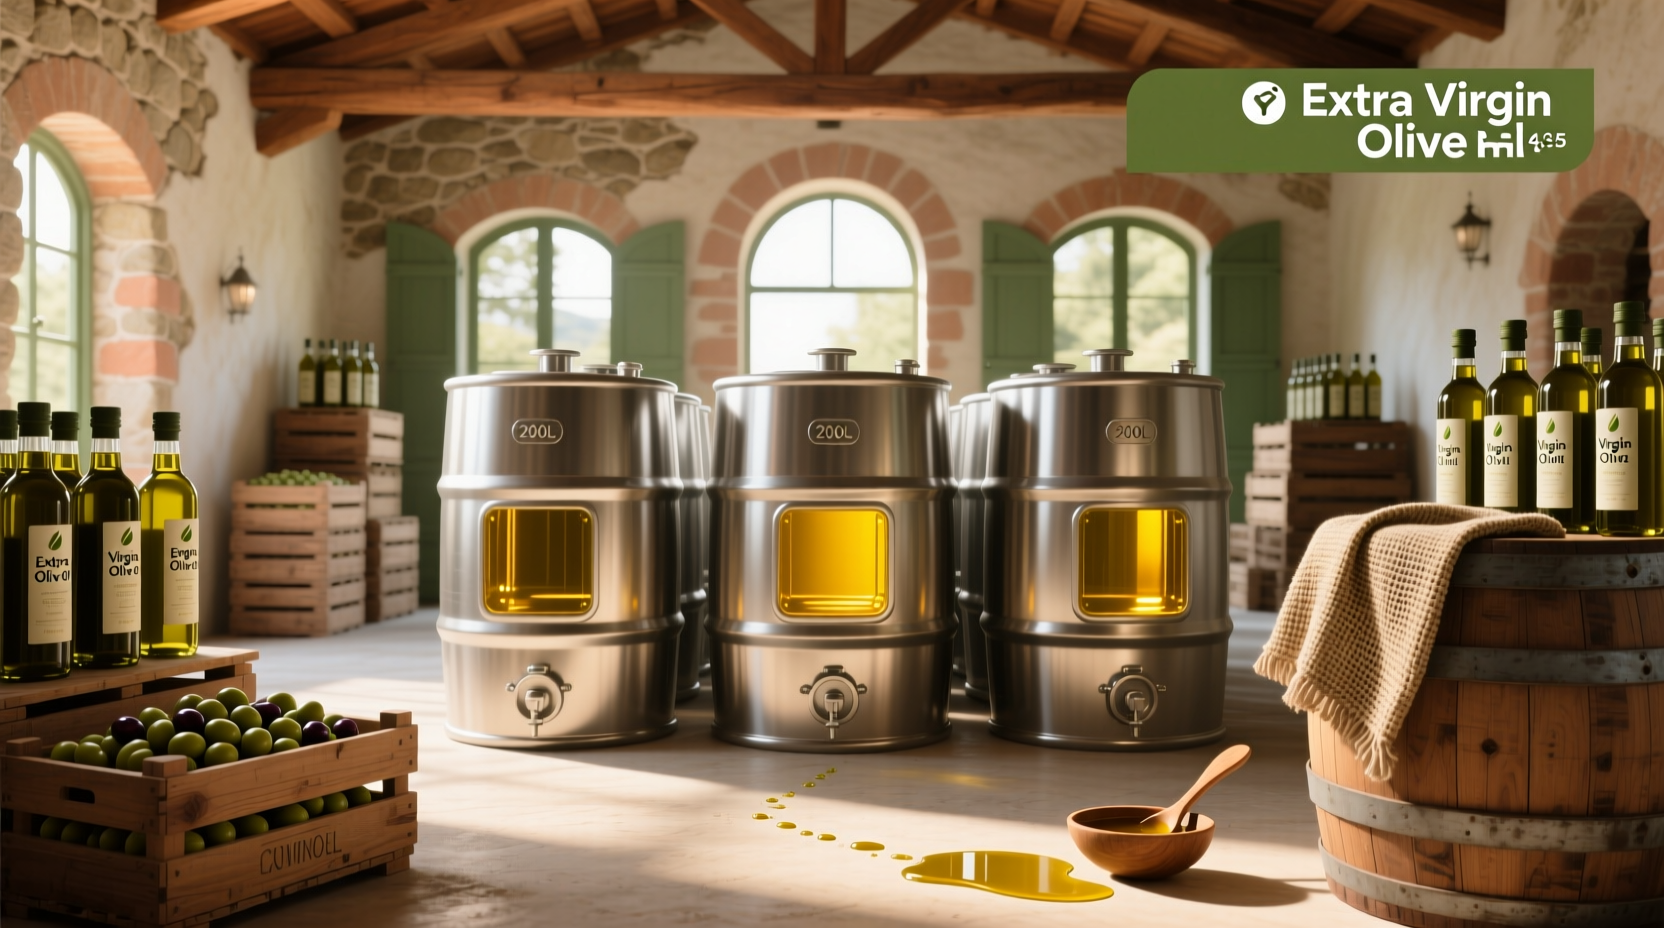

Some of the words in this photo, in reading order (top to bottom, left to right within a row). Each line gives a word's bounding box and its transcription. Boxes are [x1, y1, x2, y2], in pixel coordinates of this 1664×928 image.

[519, 424, 556, 439] 200L
[815, 424, 853, 439] 200L
[1599, 437, 1632, 453] Virgin
[108, 550, 139, 566] Virgin
